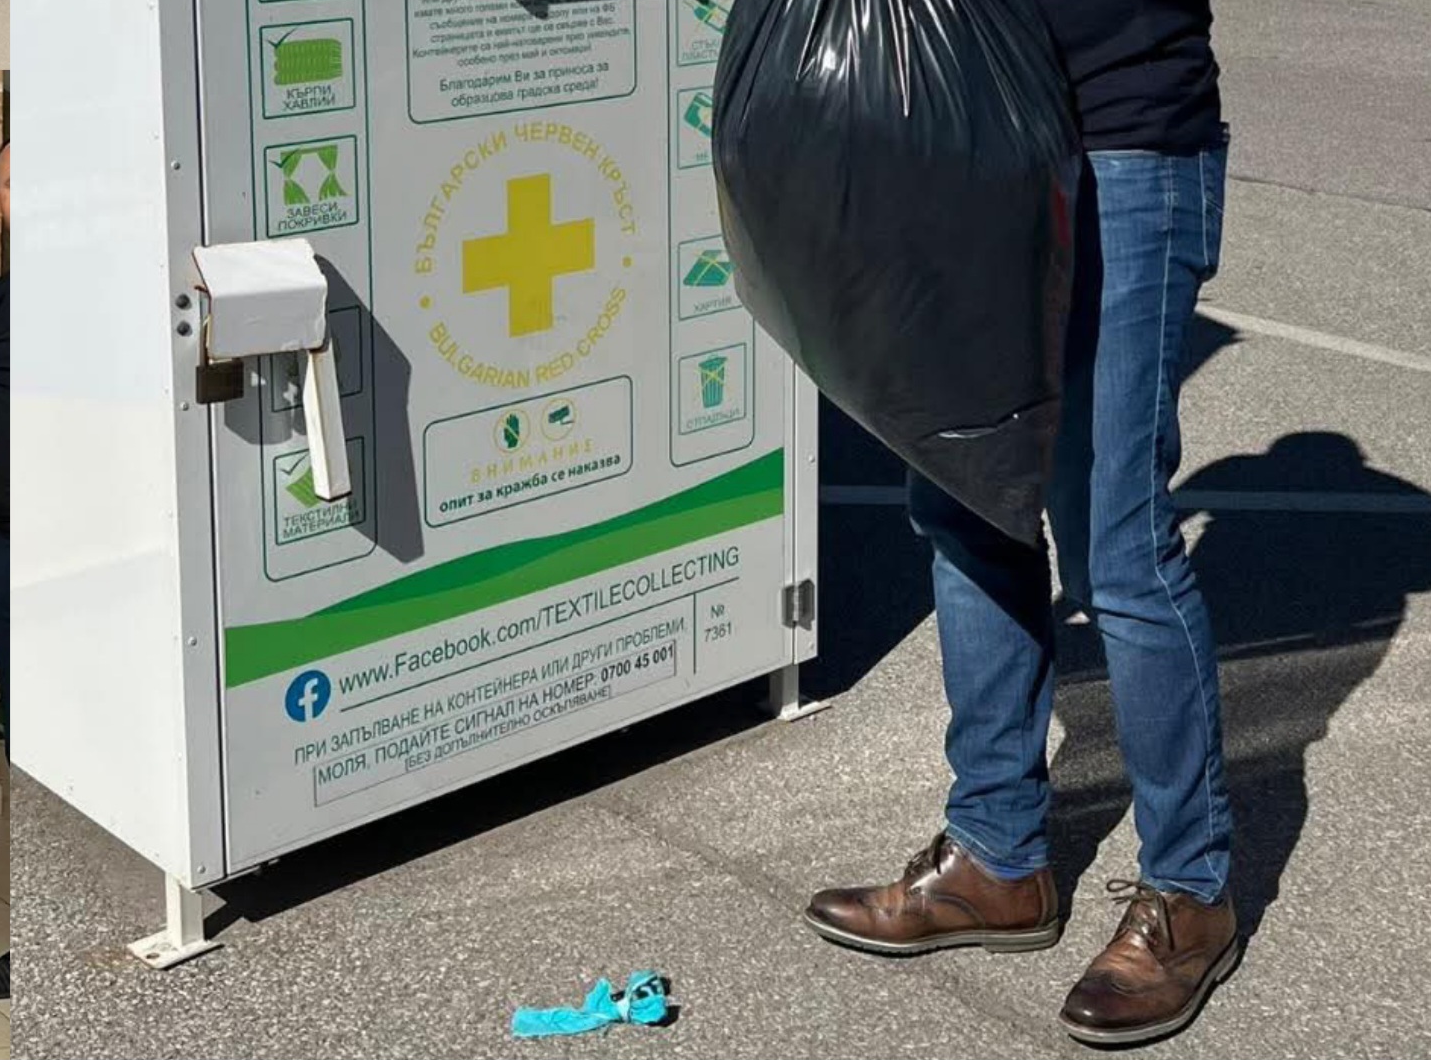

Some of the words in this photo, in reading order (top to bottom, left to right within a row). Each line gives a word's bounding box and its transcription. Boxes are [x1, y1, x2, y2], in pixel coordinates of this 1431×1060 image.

[439, 71, 512, 92] Благодарим
[514, 70, 530, 82] Ви
[533, 69, 546, 80] за
[548, 64, 594, 82] приноса
[596, 61, 610, 73] за
[451, 88, 514, 108] образцова
[516, 84, 561, 101] градска
[563, 77, 599, 94] среда!
[277, 210, 348, 232] ПОКРИВКИ
[414, 130, 508, 275] БЪЛГАРСКИ
[513, 121, 601, 162] ЧЕРВЕН
[597, 154, 638, 236] КРЪСТ
[428, 321, 531, 388] BULGARIAN
[534, 352, 576, 385] RED
[576, 286, 627, 358] CROSS
[439, 494, 474, 514] опит
[477, 489, 493, 504] за
[496, 473, 548, 500] кражба
[551, 469, 565, 483] се
[568, 453, 622, 478] наказва
[704, 621, 732, 642] 7361
[294, 740, 327, 765] ПРИ
[331, 708, 420, 752] ЗАПЪЛВАНЕ
[424, 702, 444, 722] НА
[448, 665, 538, 712] КОНТЕЙНЕРА
[541, 656, 569, 680] ИЛИ
[571, 642, 613, 671] ДРУГИ
[318, 755, 368, 786] МОЛЯ,
[375, 723, 450, 764] ПОДАЙТЕ
[454, 699, 515, 735] СИГНАЛ
[518, 692, 539, 713] НА
[601, 662, 631, 684] 0700
[635, 654, 650, 670] 45
[653, 643, 675, 665] 001
[434, 714, 530, 760] ДОПЪЛНИТЕЛНО
